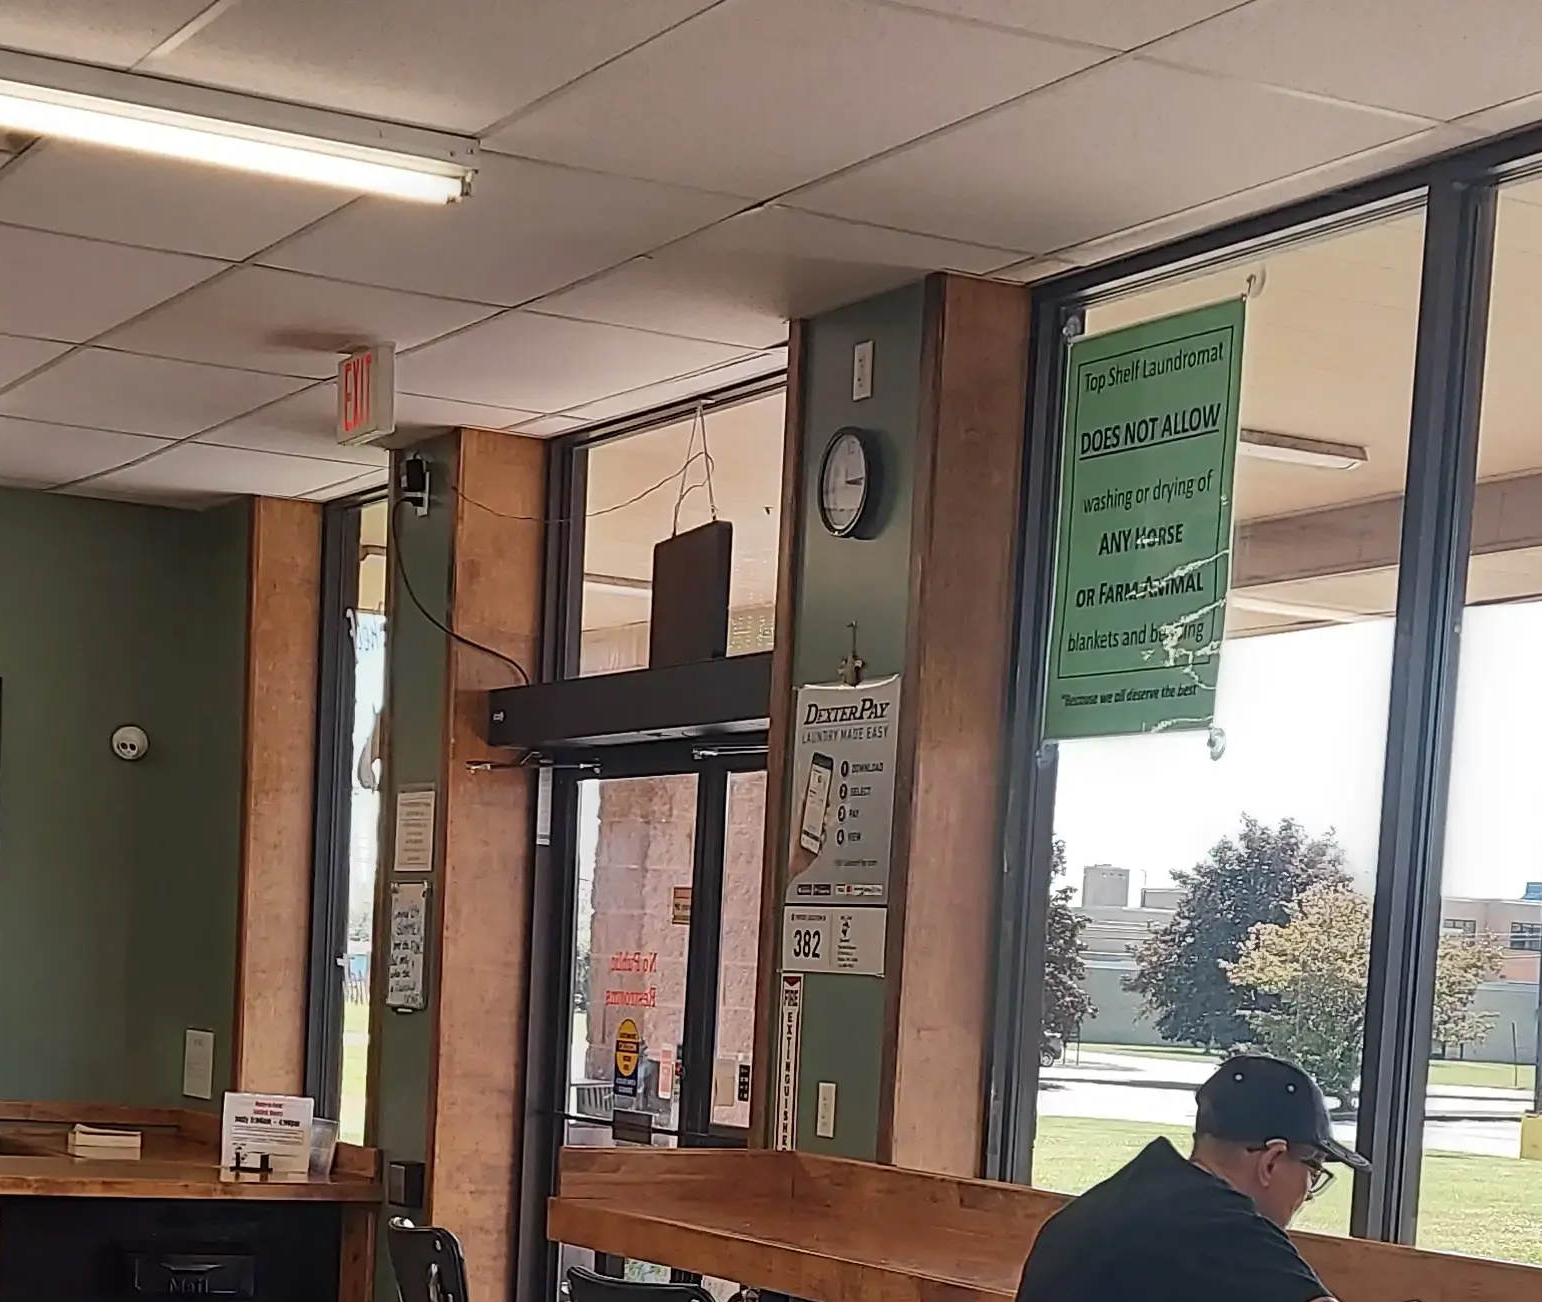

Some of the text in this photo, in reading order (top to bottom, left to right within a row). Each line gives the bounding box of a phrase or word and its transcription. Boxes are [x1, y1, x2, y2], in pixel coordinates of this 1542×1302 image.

[1085, 341, 1224, 395] Top Shelf Laundromat
[344, 354, 372, 432] EXIT
[1080, 403, 1222, 455] DOES NOT ALLOW
[1083, 468, 1214, 514] washing or drying of
[1098, 524, 1184, 556] ANY HORSE
[1076, 571, 1204, 608] OR FARM ANIMAL
[1067, 622, 1204, 652] blankets and being
[1127, 688, 1159, 702] deserve
[1161, 685, 1176, 698] the
[801, 725, 889, 745] LAUNDRY MADE EASY
[851, 762, 884, 773] DOWNLOAD
[850, 786, 871, 797] SELECT
[849, 809, 860, 818] PAY
[848, 832, 861, 842] VIEW
[793, 929, 821, 959] 382
[780, 1011, 794, 1151] EXTINGUISHE
[169, 1277, 209, 1294] Mail
